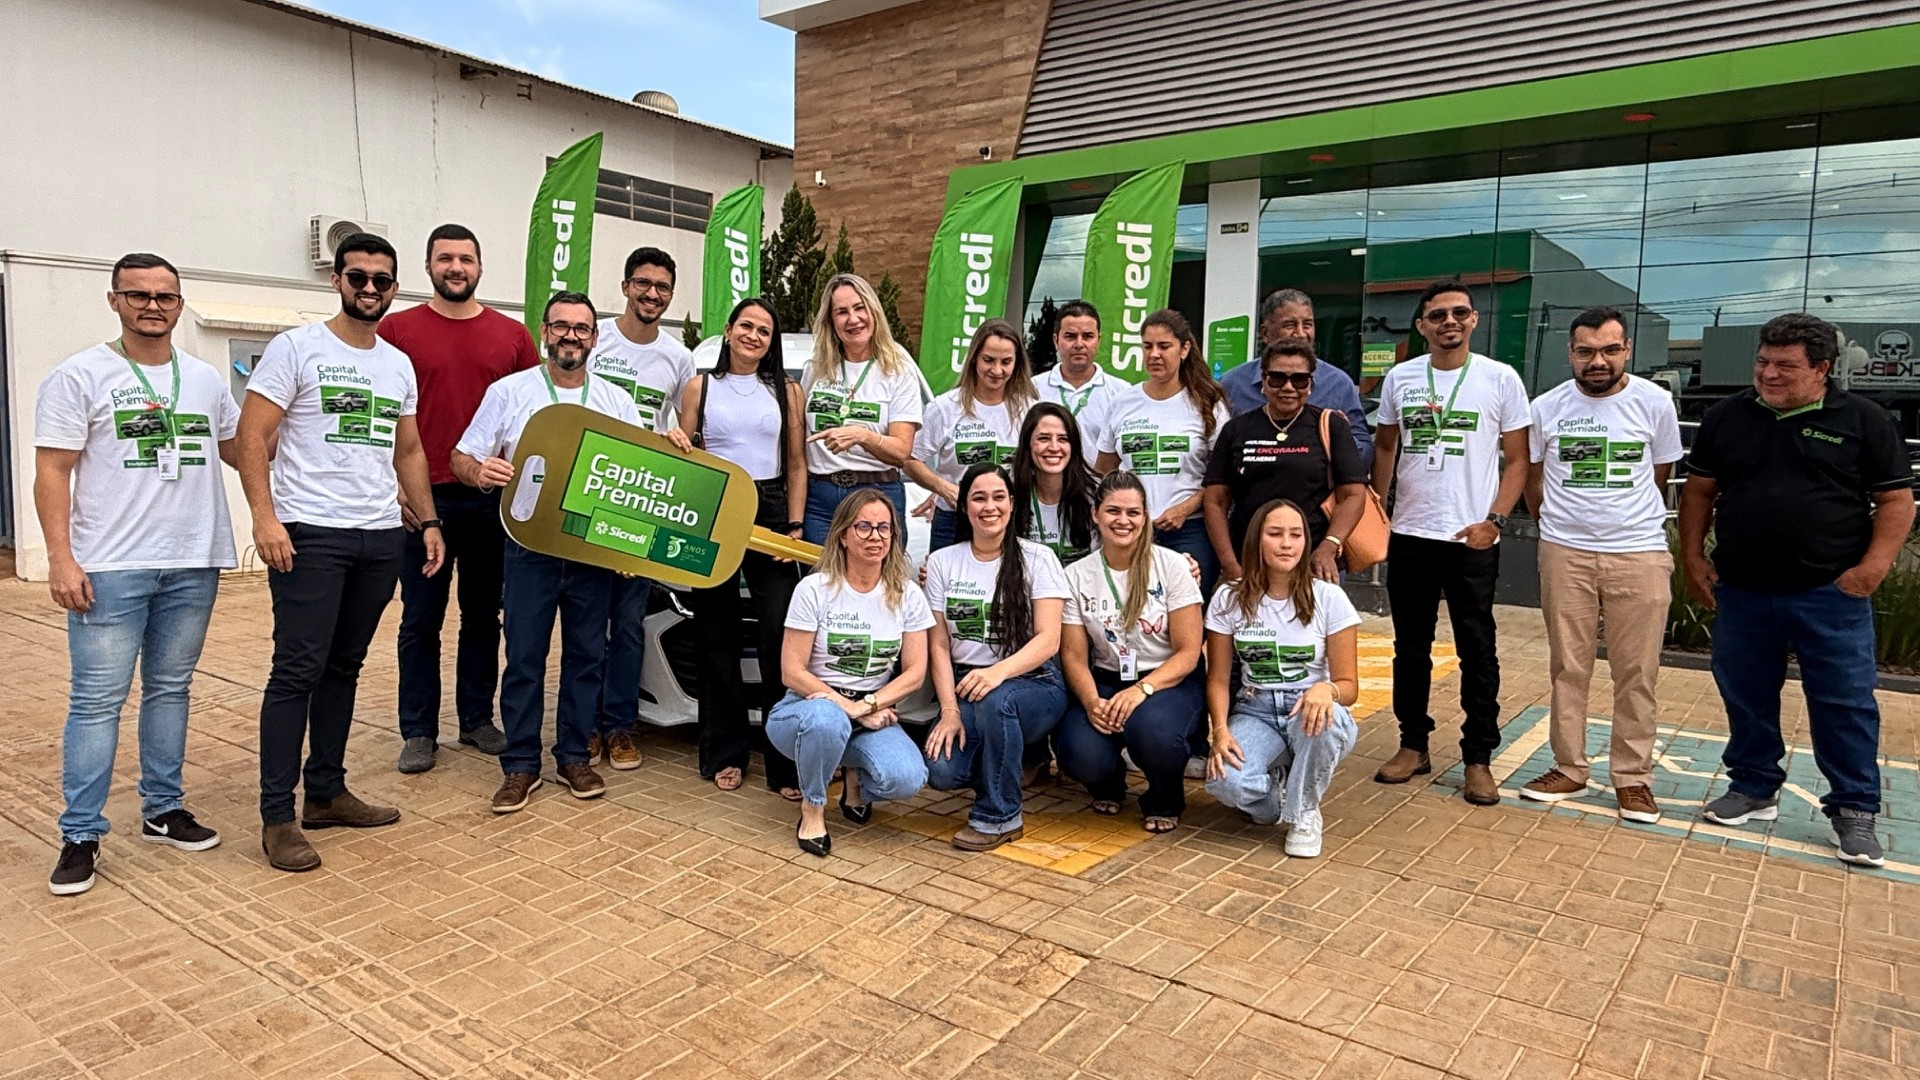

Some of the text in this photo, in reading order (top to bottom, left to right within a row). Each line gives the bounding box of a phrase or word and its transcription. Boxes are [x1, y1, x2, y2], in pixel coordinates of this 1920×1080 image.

[724, 226, 750, 307] redi
[1111, 222, 1153, 372] Sicredi
[595, 354, 628, 366] Capital
[317, 364, 358, 374] Capital
[594, 362, 639, 376] Premiado
[318, 373, 372, 386] Premiado
[110, 385, 148, 399] Capita
[1403, 387, 1430, 396] Capita
[955, 422, 986, 432] Capital
[1557, 416, 1595, 428] Capital
[955, 430, 996, 440] Premiado
[1556, 424, 1609, 434] Premiado
[590, 453, 676, 498] Capital
[583, 474, 699, 527] Premiado
[608, 526, 648, 545] Sicredi
[683, 544, 707, 556] ANOS
[826, 611, 860, 621] Capital
[826, 620, 872, 630] Premiado
